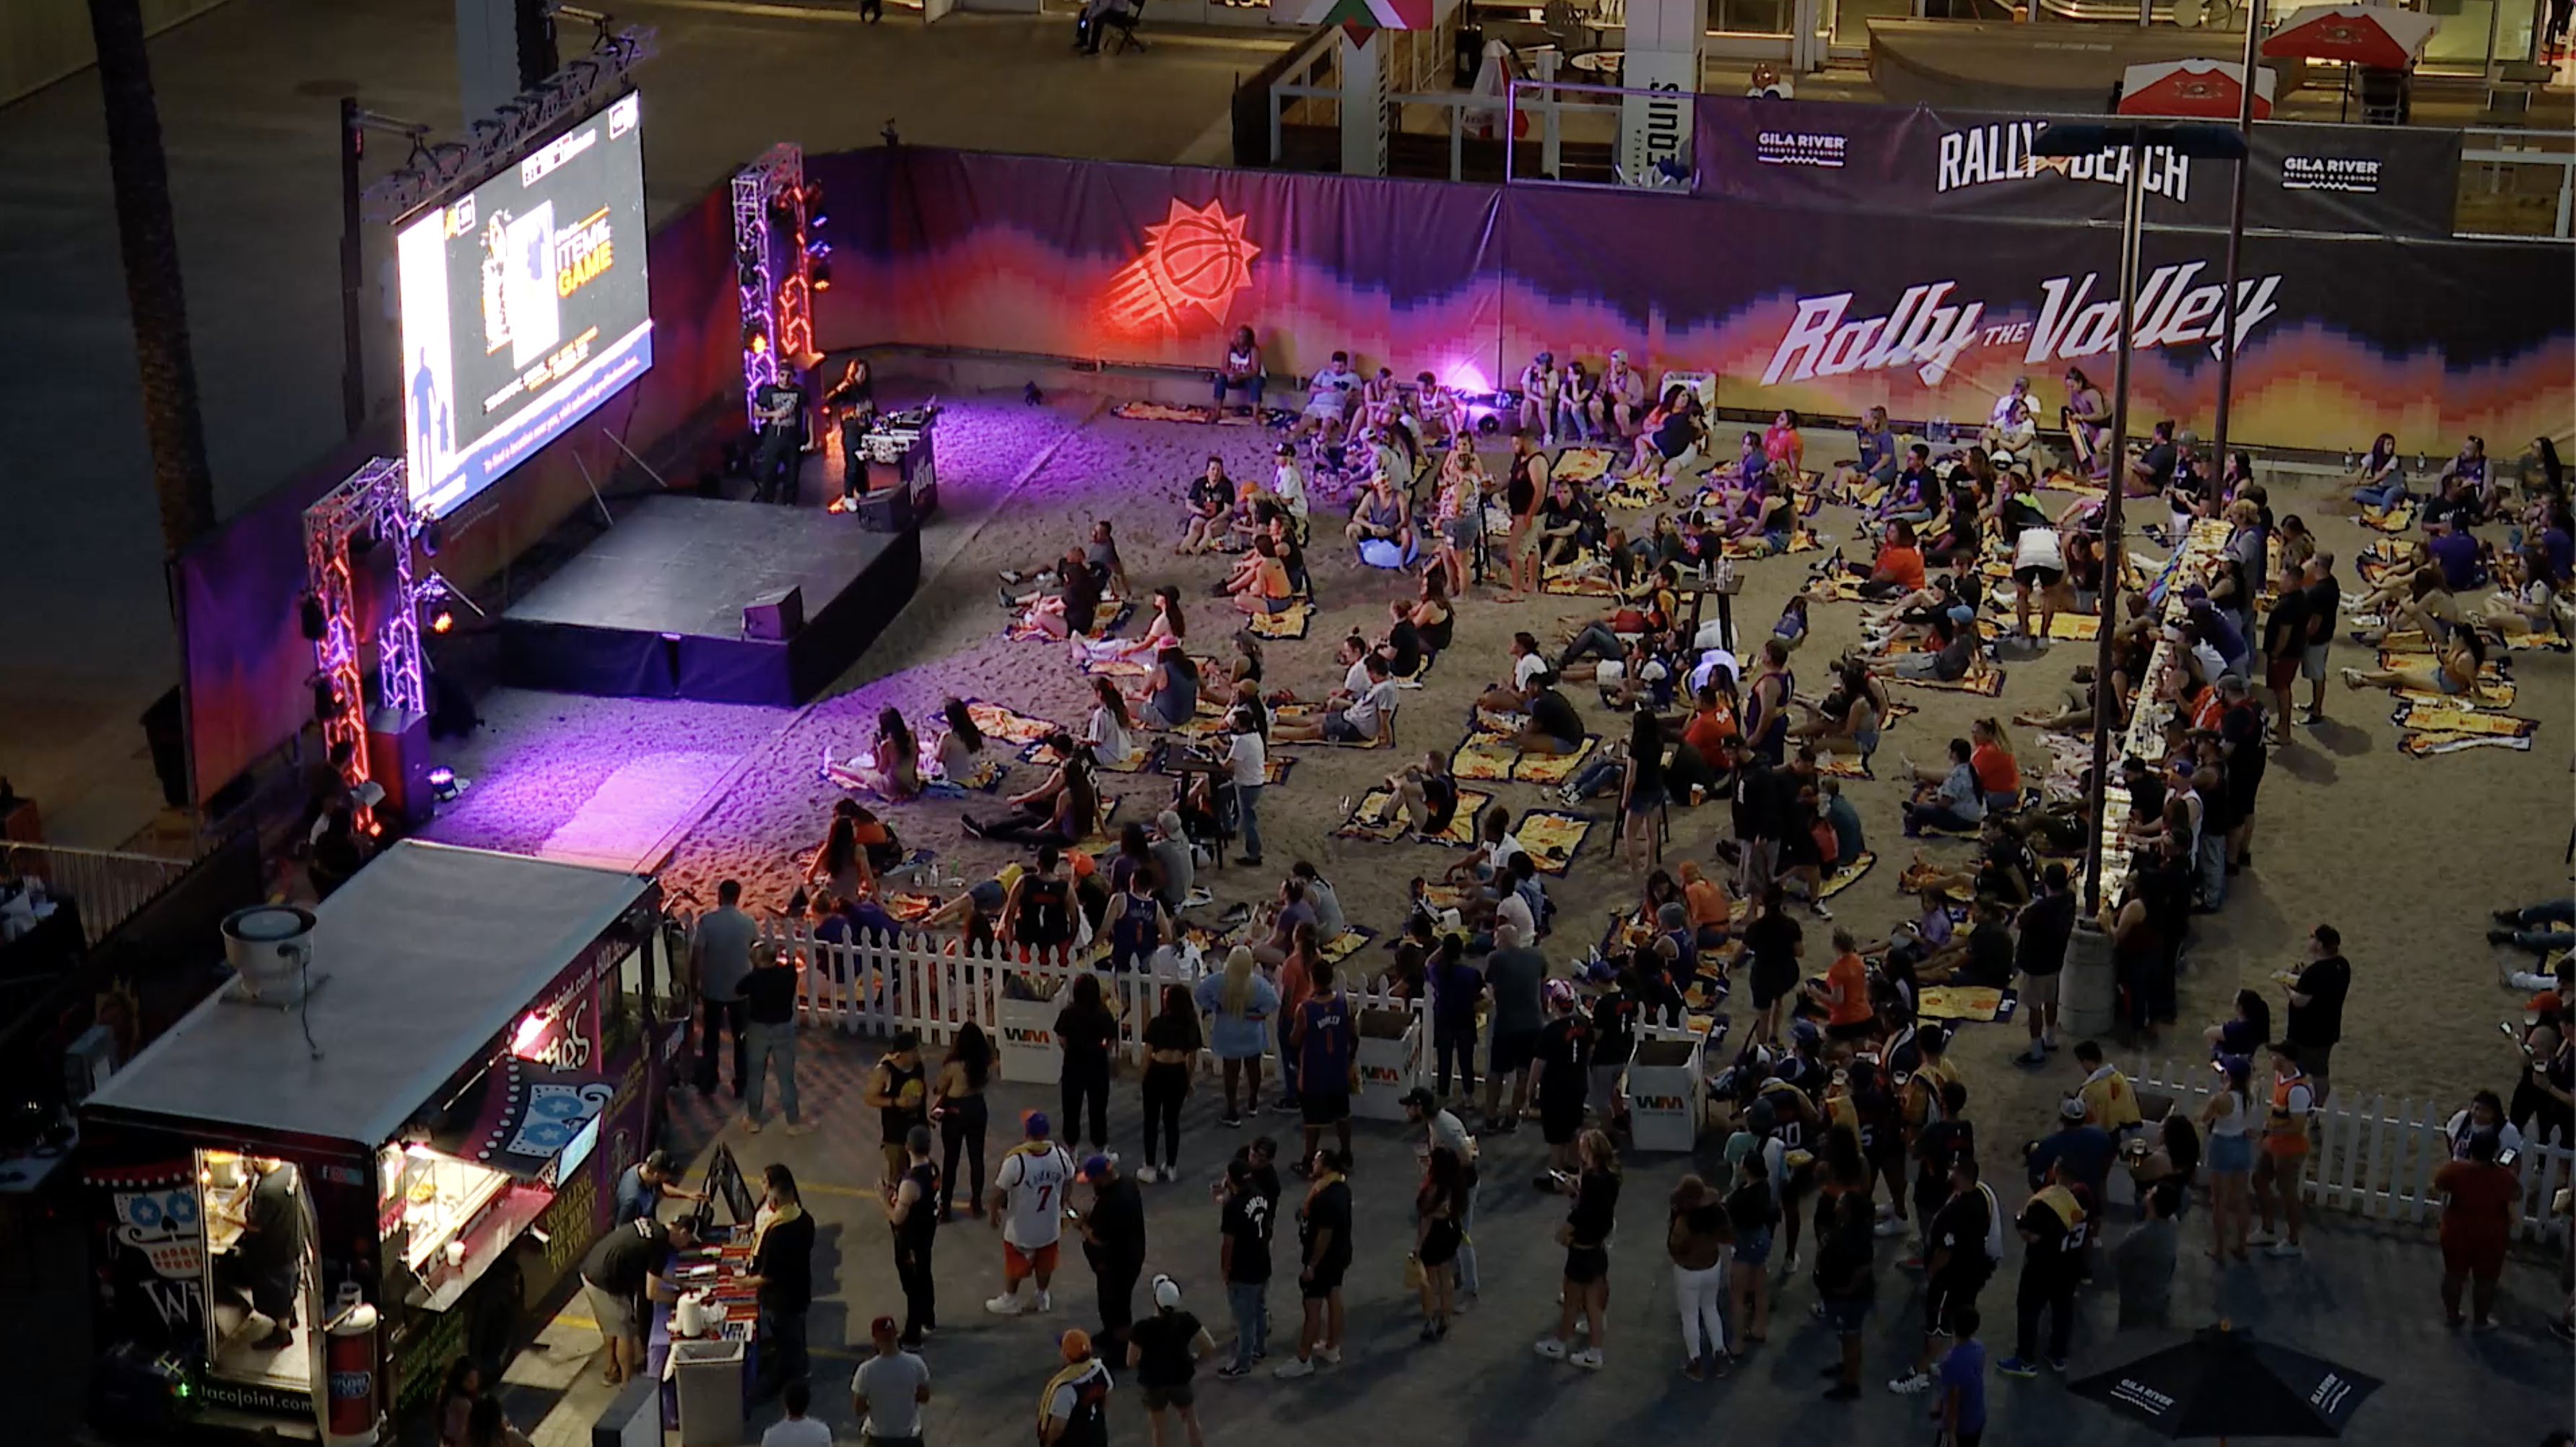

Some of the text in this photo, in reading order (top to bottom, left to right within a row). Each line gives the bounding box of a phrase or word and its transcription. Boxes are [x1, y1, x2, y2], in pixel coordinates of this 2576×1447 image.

[1758, 132, 1845, 149] GILA RIVER
[1937, 121, 2049, 194] RALLY
[2284, 157, 2378, 174] GILA RIVER
[557, 240, 613, 297] GAME
[1759, 259, 2284, 387] Rally THE Valley
[1004, 1027, 1049, 1043] WM
[1635, 1095, 1684, 1108] WM
[1037, 1184, 1053, 1212] 7
